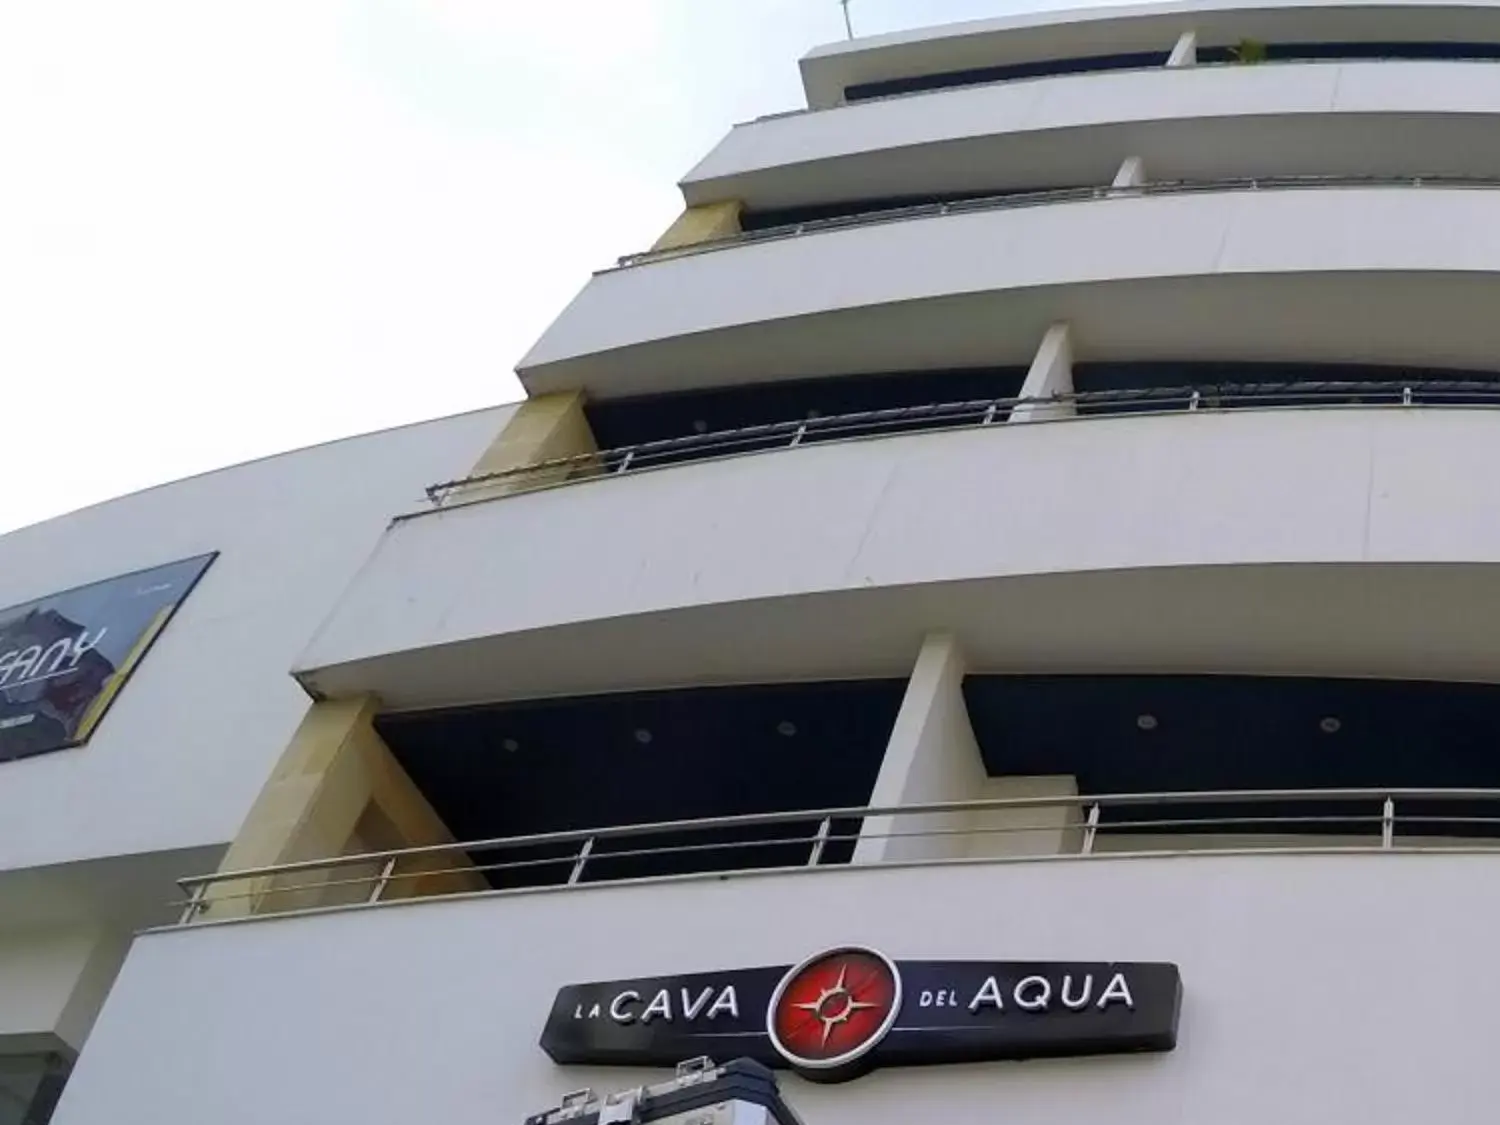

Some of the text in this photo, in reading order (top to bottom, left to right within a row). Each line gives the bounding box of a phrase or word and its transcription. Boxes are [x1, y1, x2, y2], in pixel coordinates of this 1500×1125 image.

[573, 973, 1136, 1024] LA CAVA DEL AQUA
